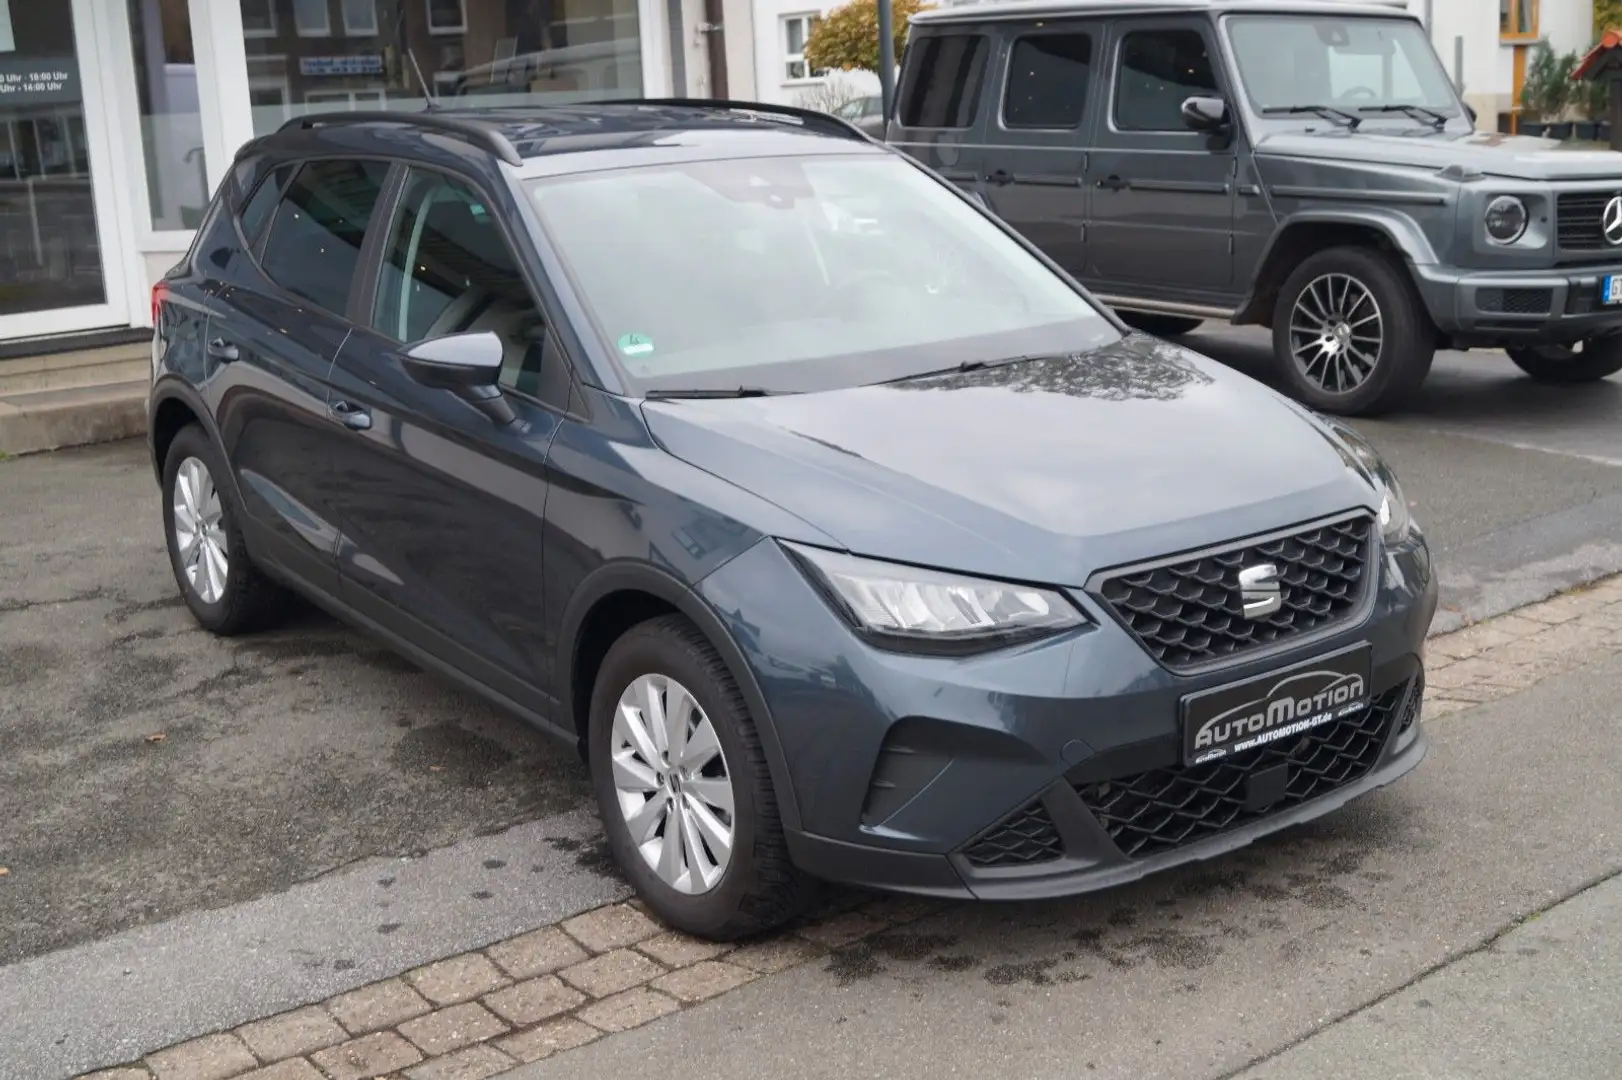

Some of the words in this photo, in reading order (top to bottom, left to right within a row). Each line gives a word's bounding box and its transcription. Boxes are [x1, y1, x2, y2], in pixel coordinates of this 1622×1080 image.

[6, 73, 21, 82] Uhr
[52, 70, 68, 80] Uhr
[46, 81, 62, 91] Uhr
